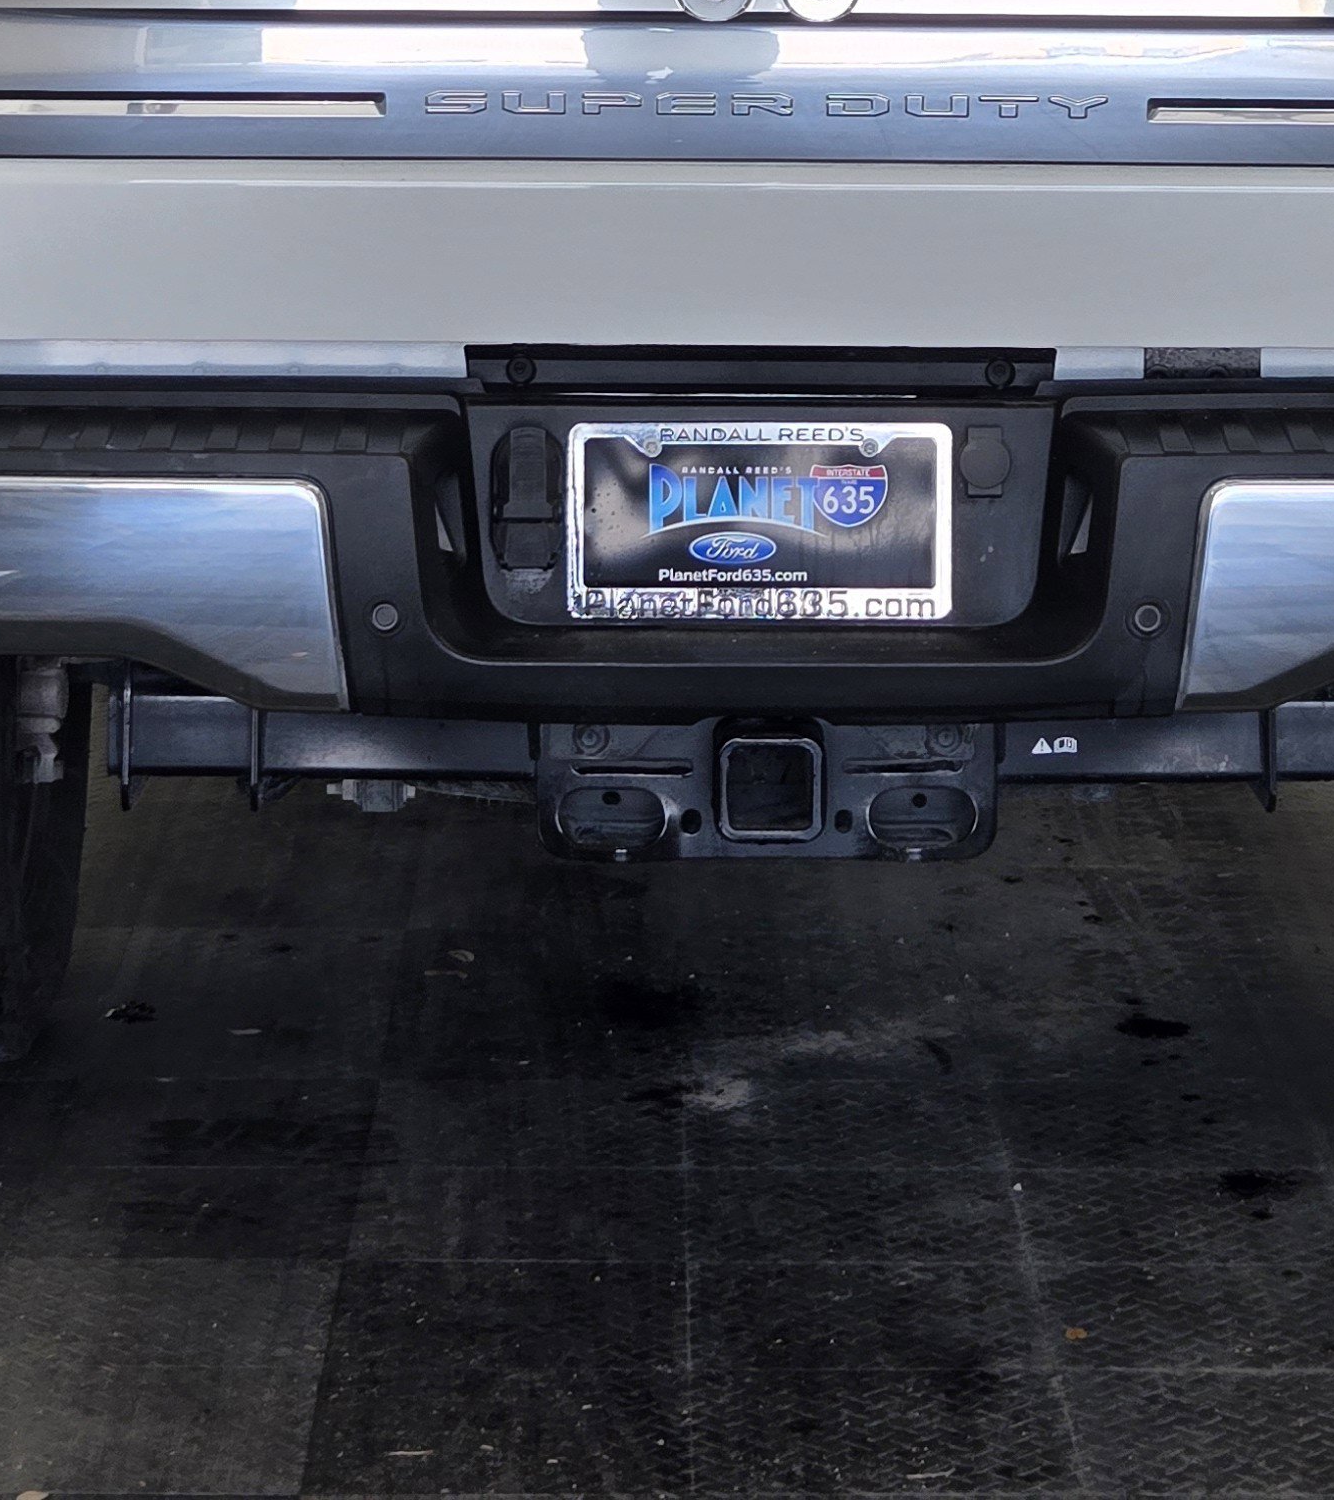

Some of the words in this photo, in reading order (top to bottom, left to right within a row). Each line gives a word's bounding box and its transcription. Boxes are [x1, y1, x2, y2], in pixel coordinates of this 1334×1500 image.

[424, 89, 796, 118] SUPER
[826, 92, 1110, 120] DUTY
[660, 427, 771, 442] RANDALL
[778, 427, 865, 442] REED'S
[681, 466, 740, 475] RANDALL
[826, 468, 870, 477] INTERSTATE
[649, 463, 820, 534] PLANET
[823, 485, 875, 514] 635
[705, 536, 759, 561] Ford
[658, 568, 808, 582] PlanetFord635.com
